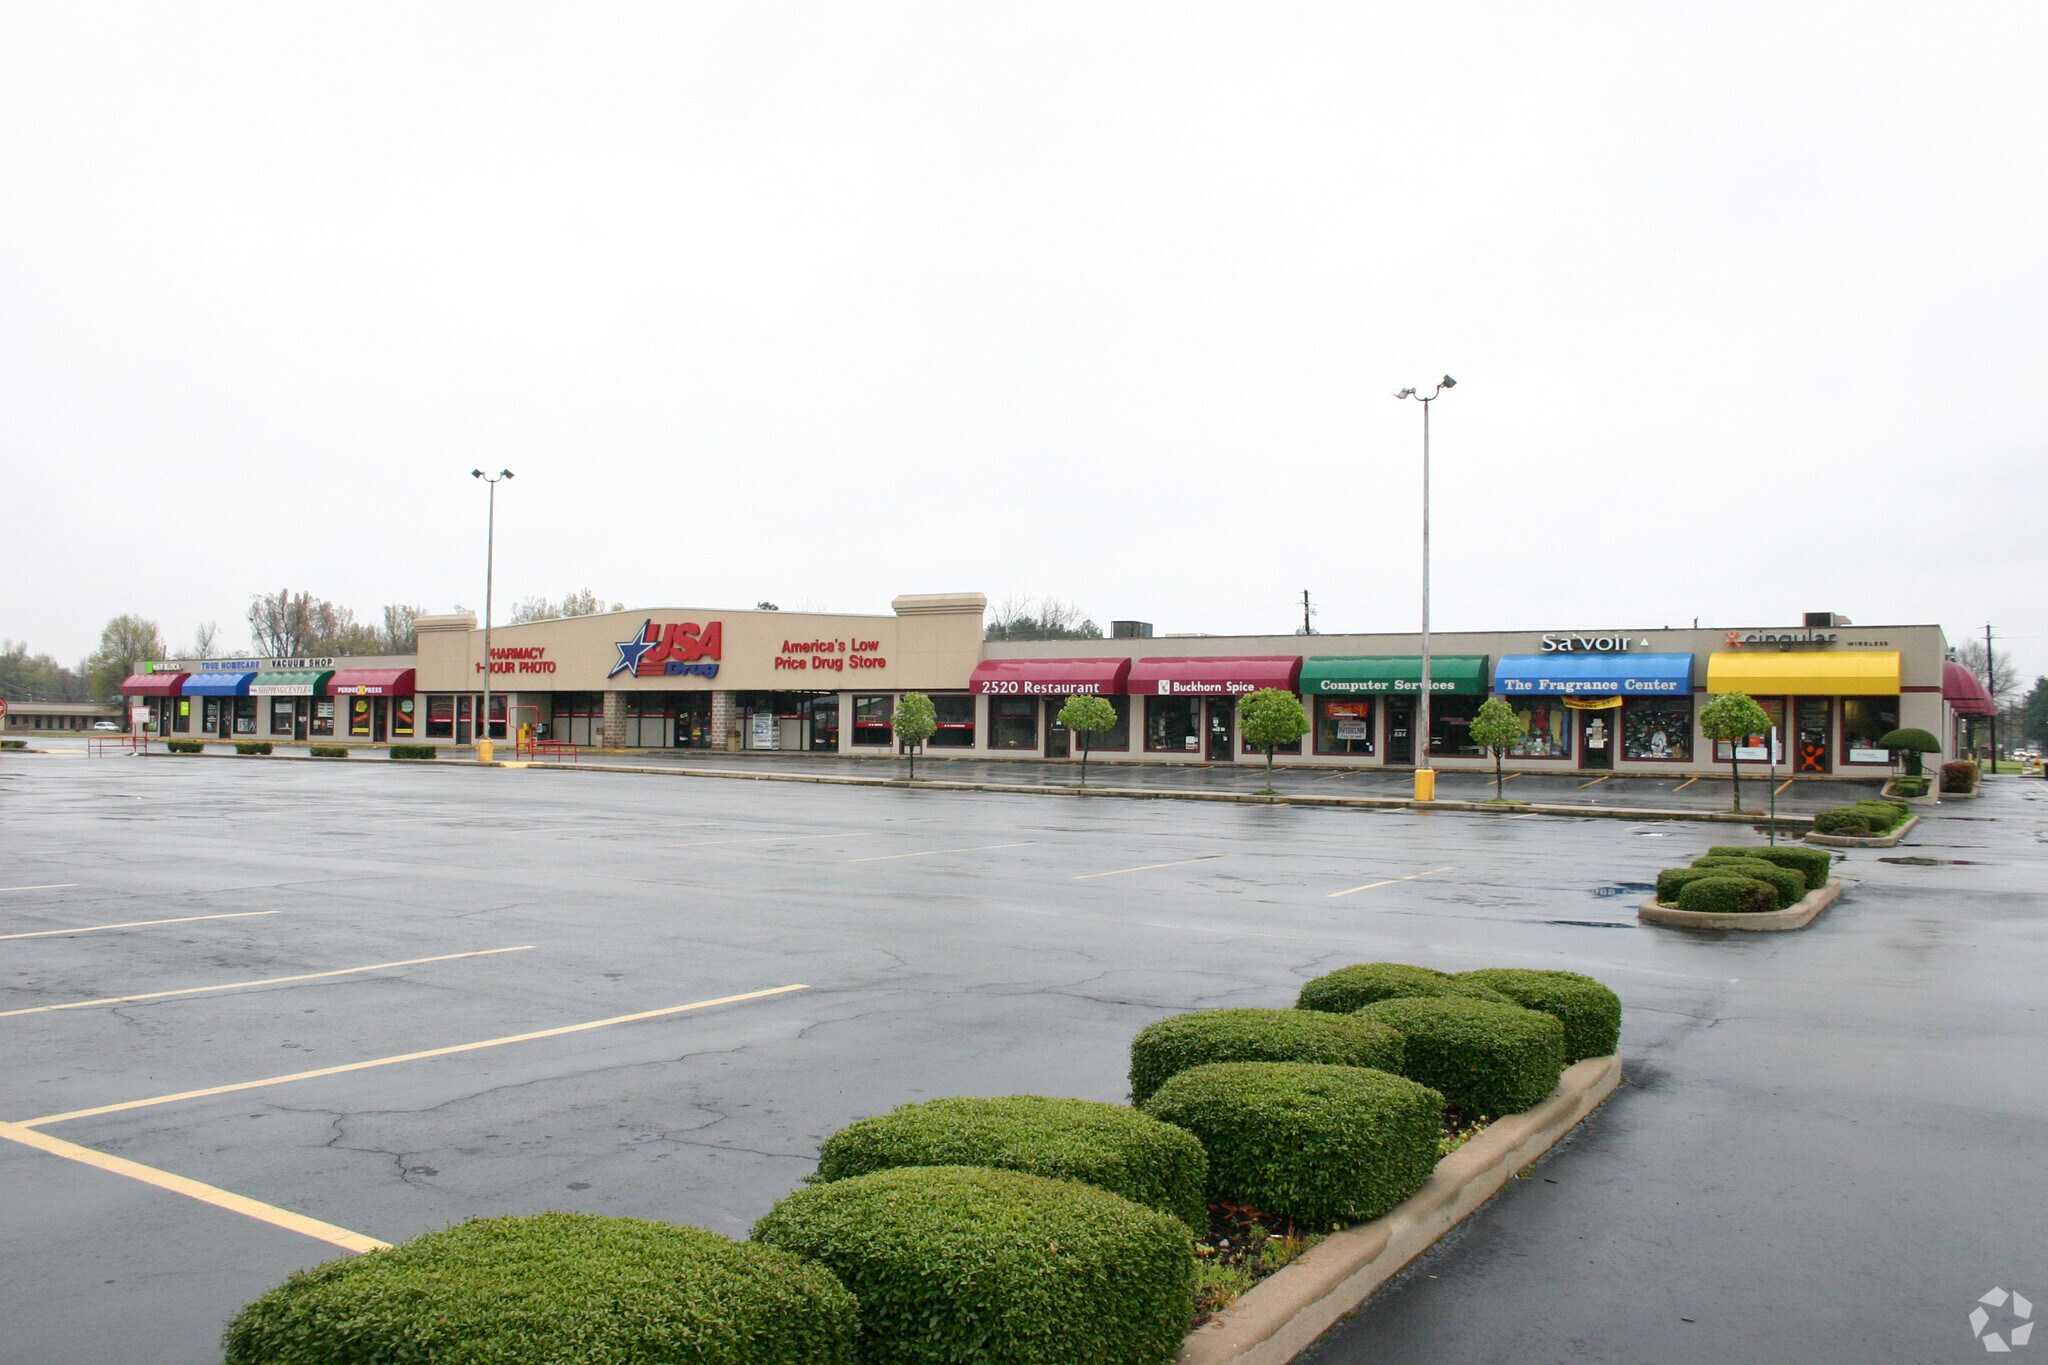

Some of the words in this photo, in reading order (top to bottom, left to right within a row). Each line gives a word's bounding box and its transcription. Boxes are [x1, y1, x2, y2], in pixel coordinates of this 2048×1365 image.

[643, 621, 722, 662] USA
[781, 638, 847, 654] America's
[851, 638, 880, 652] Low
[1745, 628, 1837, 651] cingular
[221, 661, 260, 669] HOMECARE
[271, 659, 305, 668] VACUUM
[309, 658, 334, 667] SHOP
[519, 661, 557, 673] PHOTO
[774, 656, 807, 670] Price
[812, 655, 844, 672] Drug
[849, 654, 887, 669] Store
[665, 661, 720, 679] Drug
[982, 681, 1019, 693] 2520
[1024, 681, 1100, 693] Restaurant
[1173, 681, 1221, 692] Buckhorn
[1226, 681, 1255, 694] Spice
[1320, 680, 1389, 692] Computer
[1504, 679, 1533, 690] The
[1538, 679, 1619, 693] Fragrance
[1624, 679, 1678, 690] Center
